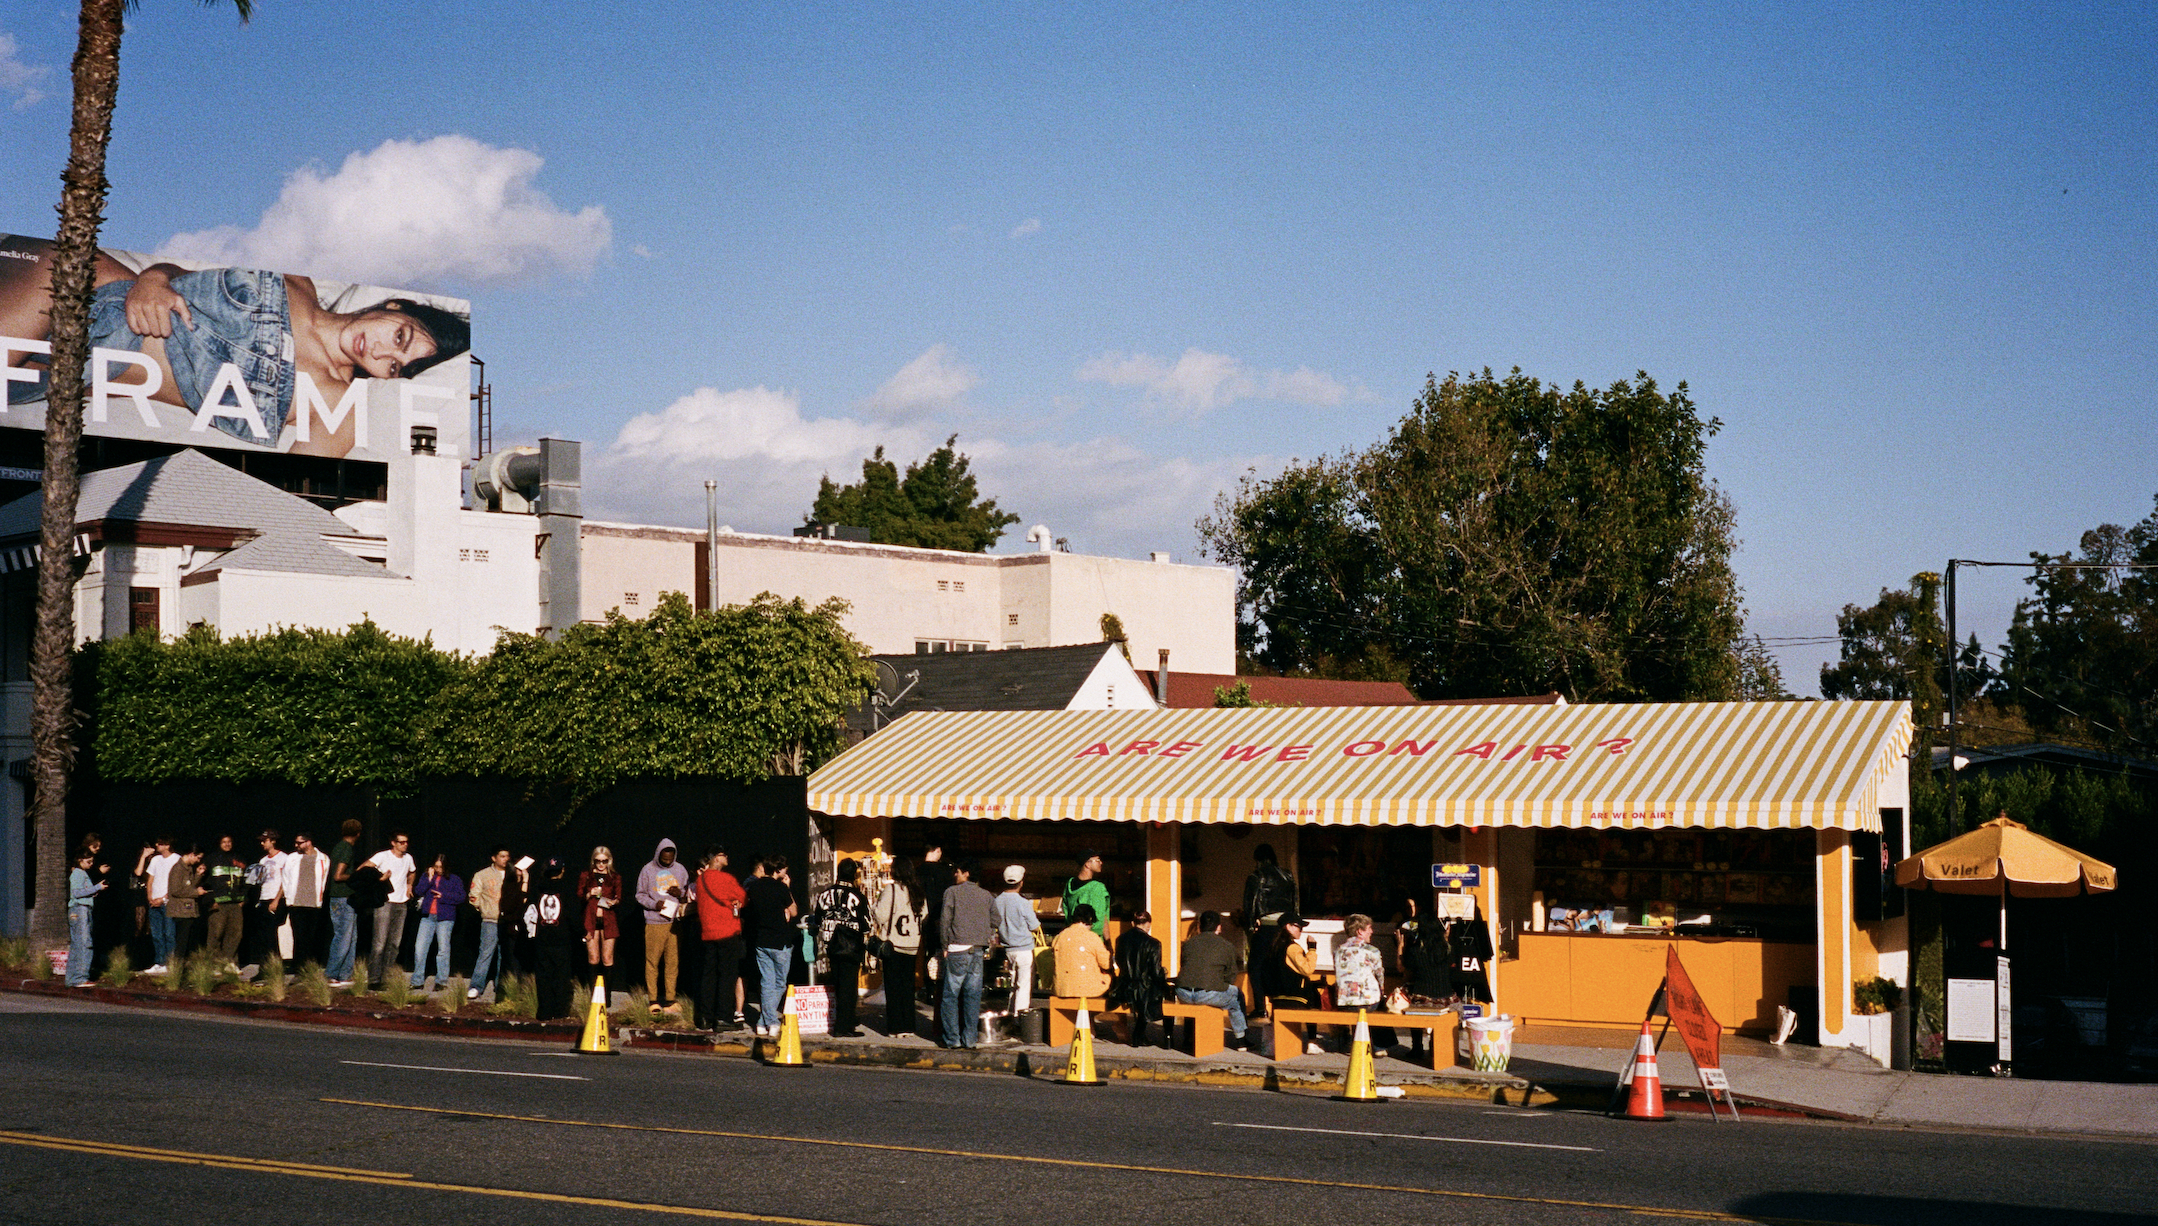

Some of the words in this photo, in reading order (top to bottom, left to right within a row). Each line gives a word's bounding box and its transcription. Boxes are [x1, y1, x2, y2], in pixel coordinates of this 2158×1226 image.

[22, 252, 40, 263] Gray
[0, 336, 458, 455] FRAME
[2, 469, 42, 480] FRONT
[1073, 741, 1204, 759] ARE
[1220, 744, 1314, 762] WE
[1343, 740, 1439, 757] ON
[1453, 741, 1572, 762] AIR
[1941, 863, 1980, 876] Valet
[796, 999, 807, 1011] NO
[598, 1005, 606, 1046] AIR
[1069, 1029, 1081, 1075] AIR
